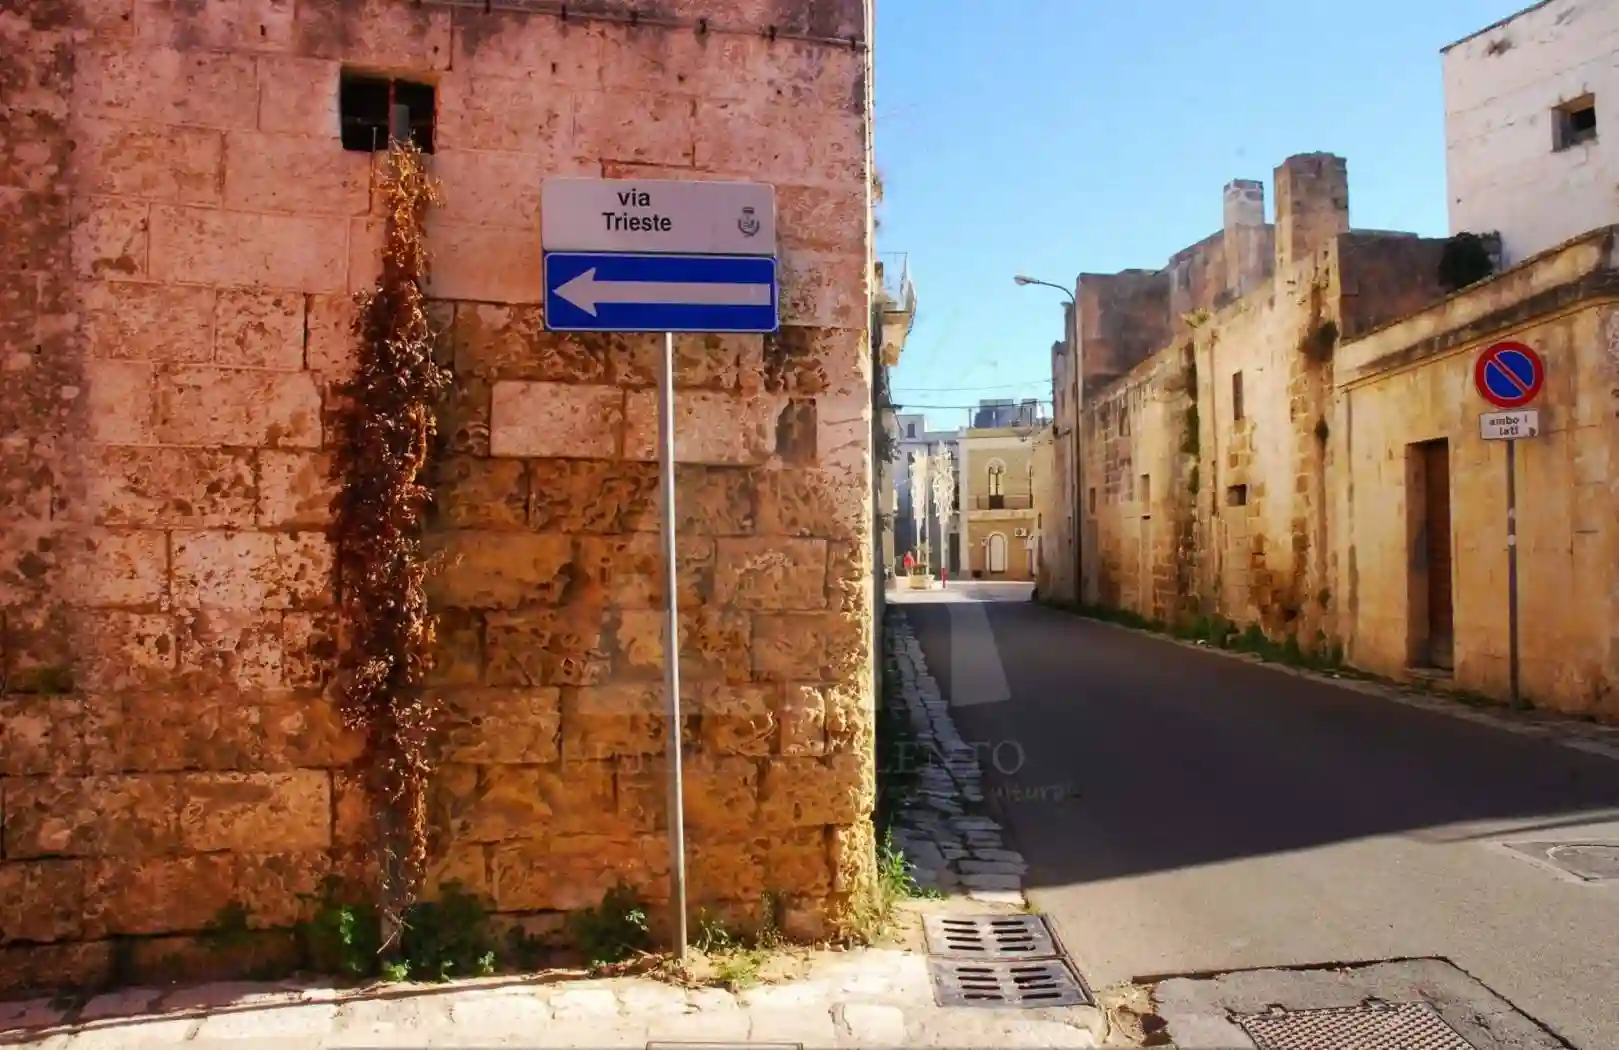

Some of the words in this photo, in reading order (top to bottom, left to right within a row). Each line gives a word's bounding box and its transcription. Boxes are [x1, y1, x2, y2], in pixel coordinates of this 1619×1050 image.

[617, 188, 651, 207] via
[602, 212, 672, 232] Trieste
[1489, 415, 1520, 426] ambo
[1499, 426, 1519, 436] lati
